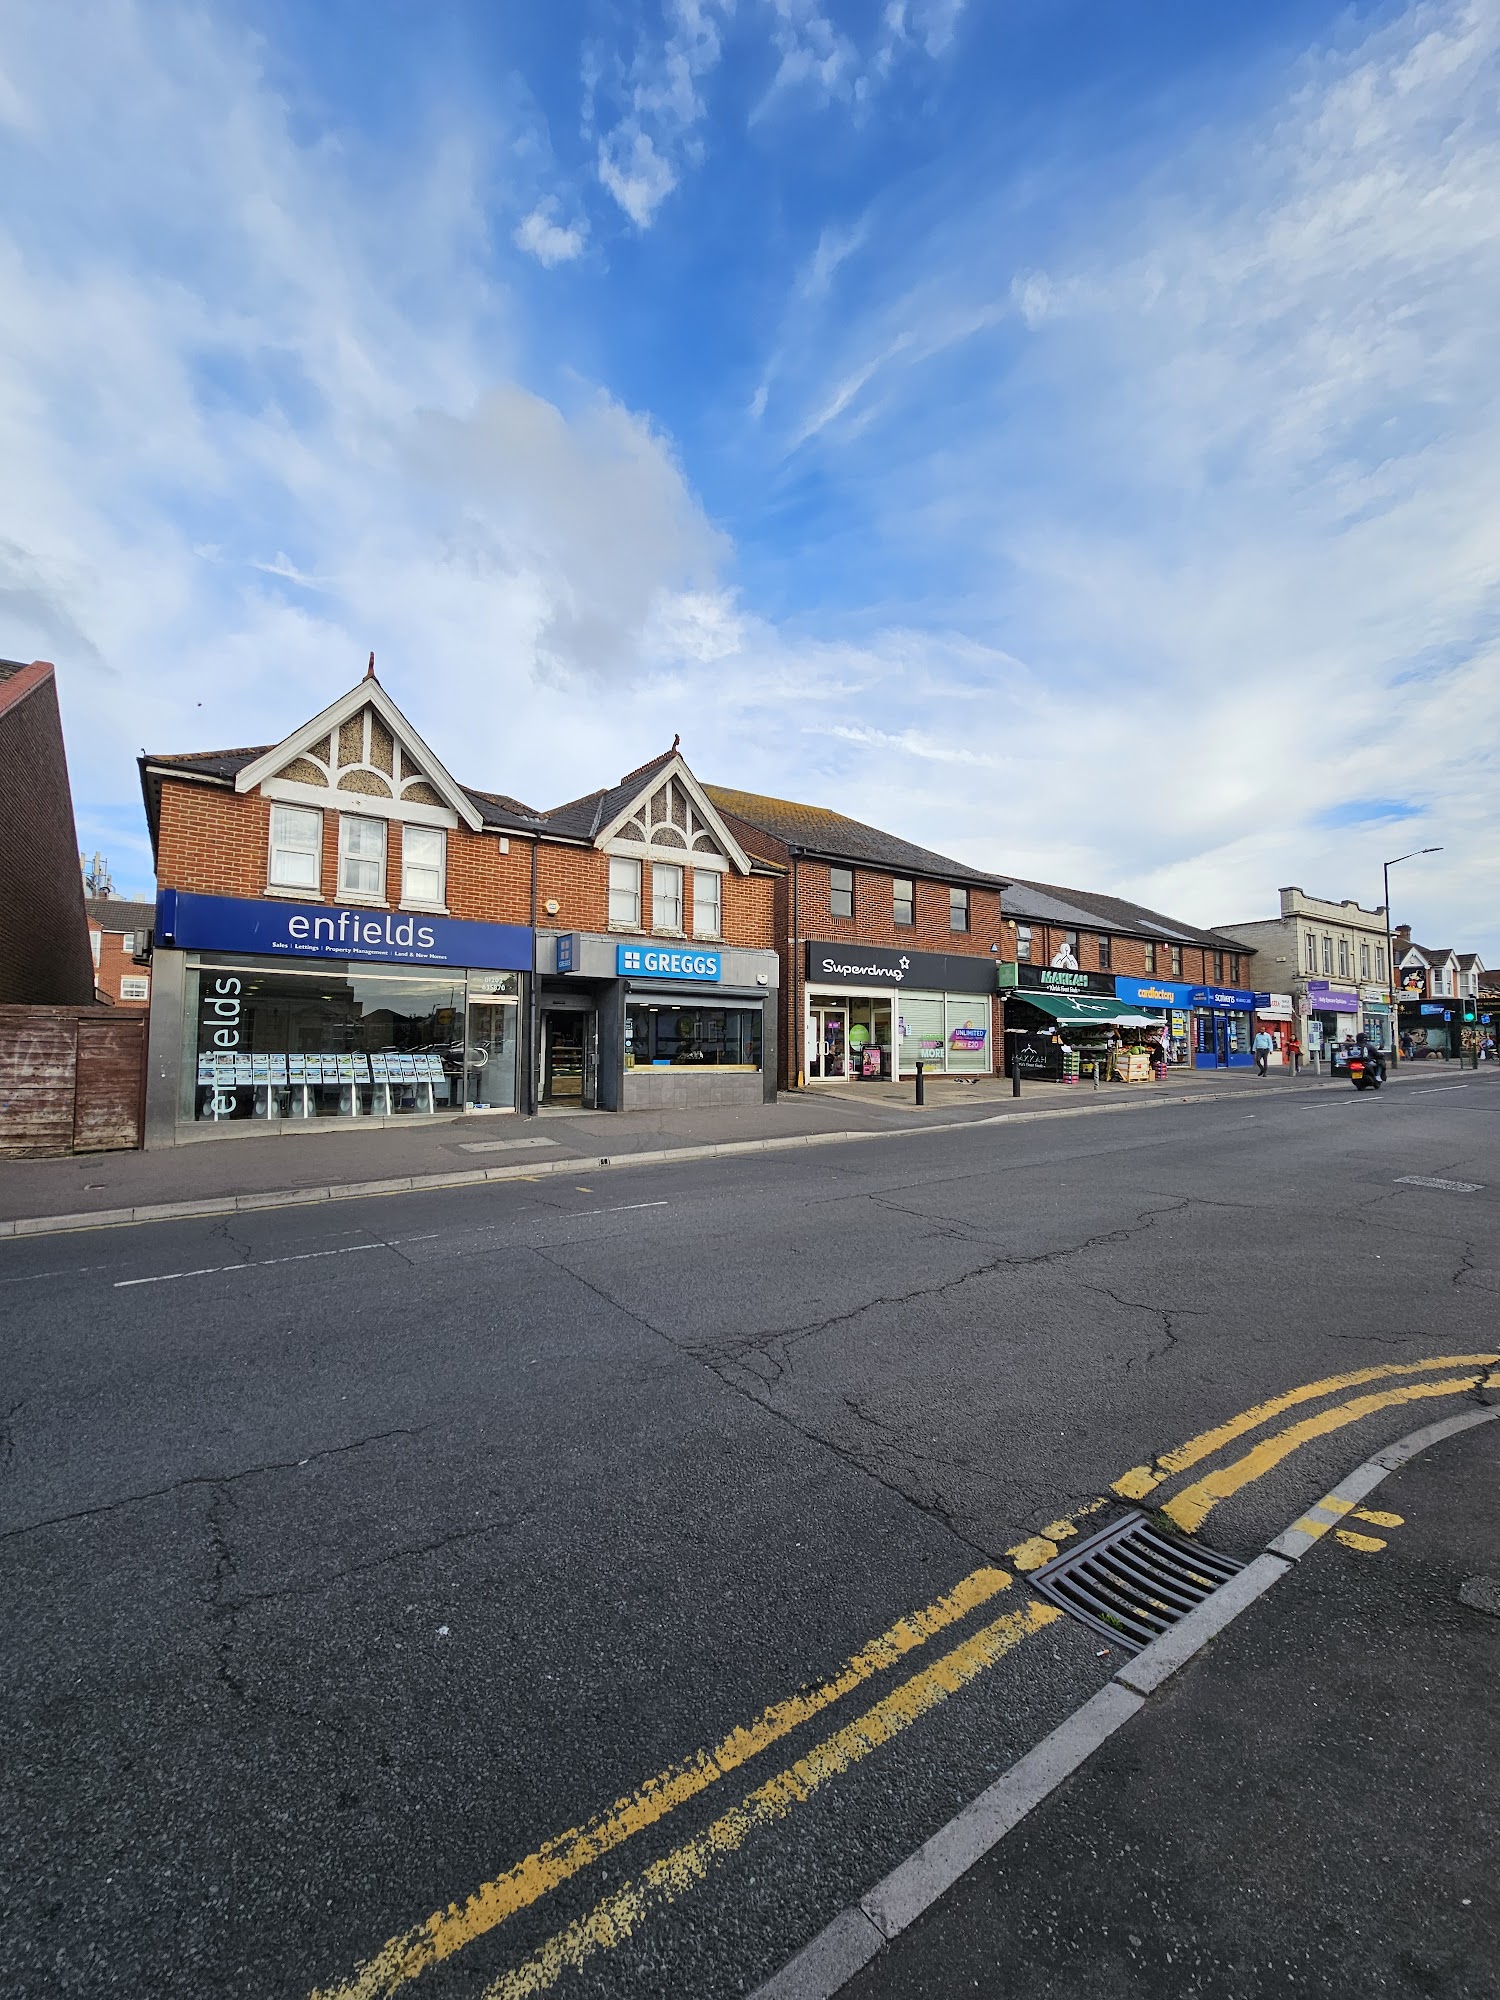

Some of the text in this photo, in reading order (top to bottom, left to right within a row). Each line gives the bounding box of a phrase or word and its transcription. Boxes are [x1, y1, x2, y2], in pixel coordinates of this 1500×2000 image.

[288, 911, 435, 948] enfields
[272, 941, 289, 949] Sales
[294, 943, 320, 951] Lettings
[325, 945, 352, 954] Property
[352, 947, 389, 956] Management
[558, 959, 572, 968] GREGGS
[644, 953, 717, 975] GREGGS
[822, 958, 904, 981] Superdrug
[484, 976, 504, 984] 01202
[1040, 970, 1088, 988] MAKKAH
[1137, 986, 1175, 1004] cardfactory
[955, 1029, 984, 1037] UNLIMITED
[921, 1048, 945, 1058] MORE
